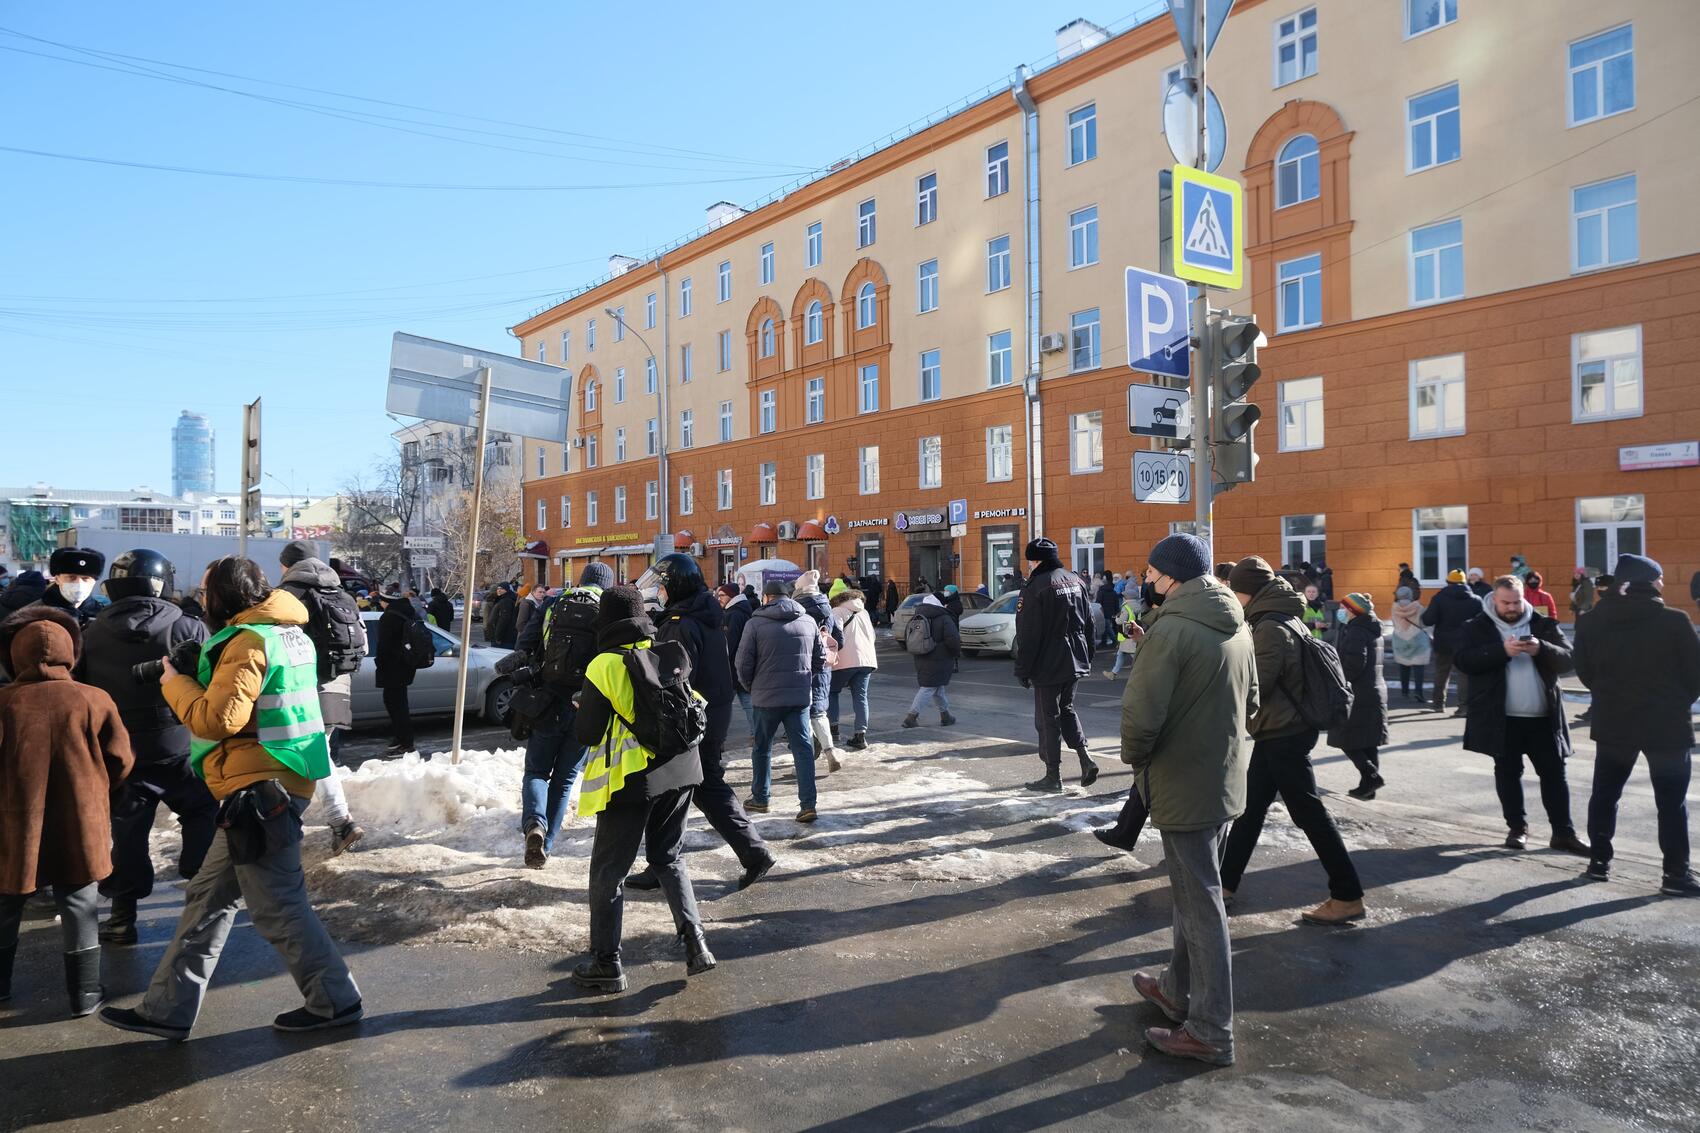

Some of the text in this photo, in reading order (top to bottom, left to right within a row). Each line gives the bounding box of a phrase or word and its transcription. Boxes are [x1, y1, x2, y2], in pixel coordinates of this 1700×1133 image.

[1141, 282, 1174, 360] P
[1140, 469, 1184, 487] 10 15 20
[927, 514, 942, 524] PRO
[953, 503, 963, 521] P
[981, 510, 1011, 518] РЕМОНТ
[854, 519, 883, 528] ЗАПЧАСТИ
